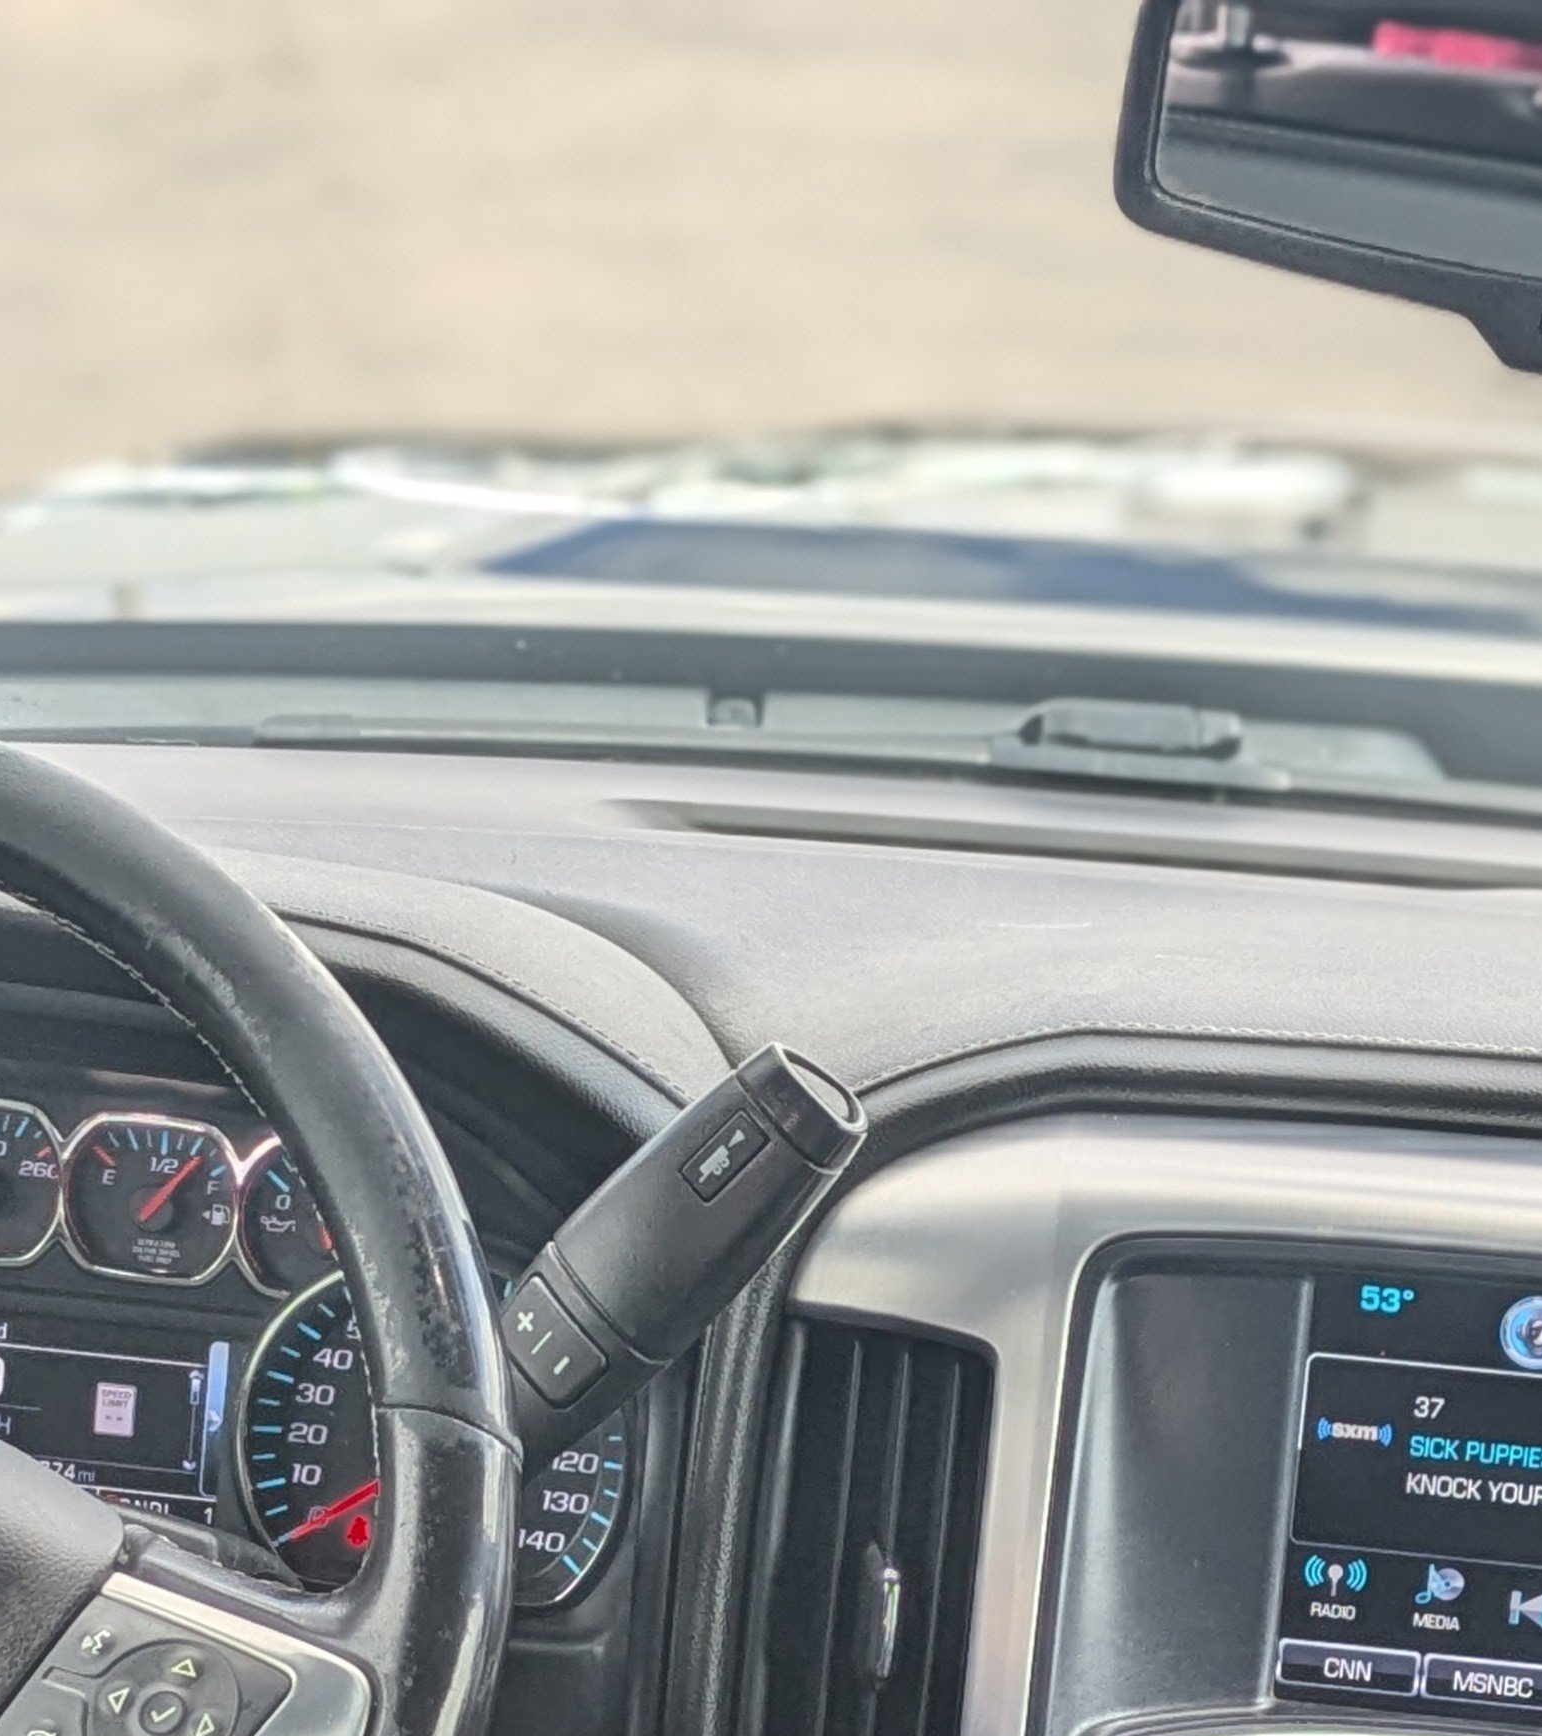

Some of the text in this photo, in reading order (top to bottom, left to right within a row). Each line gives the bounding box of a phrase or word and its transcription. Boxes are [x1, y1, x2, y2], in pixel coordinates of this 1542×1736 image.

[102, 1168, 116, 1186] E
[149, 1156, 179, 1176] 1/2
[207, 1180, 221, 1197] F
[275, 1195, 291, 1211] 0
[312, 1347, 354, 1371] 40
[296, 1383, 336, 1406] 30
[1413, 1396, 1446, 1420] 37
[287, 1422, 328, 1446] 20
[1409, 1435, 1461, 1461] SICK
[292, 1463, 322, 1487] 10
[1405, 1471, 1482, 1501] KNOCK
[542, 1491, 589, 1514] 130
[517, 1530, 566, 1553] 140
[1310, 1602, 1356, 1622] RADIO
[1413, 1613, 1461, 1632] MEDIA
[1323, 1656, 1373, 1683] CNN
[1453, 1669, 1535, 1699] MSNBC
